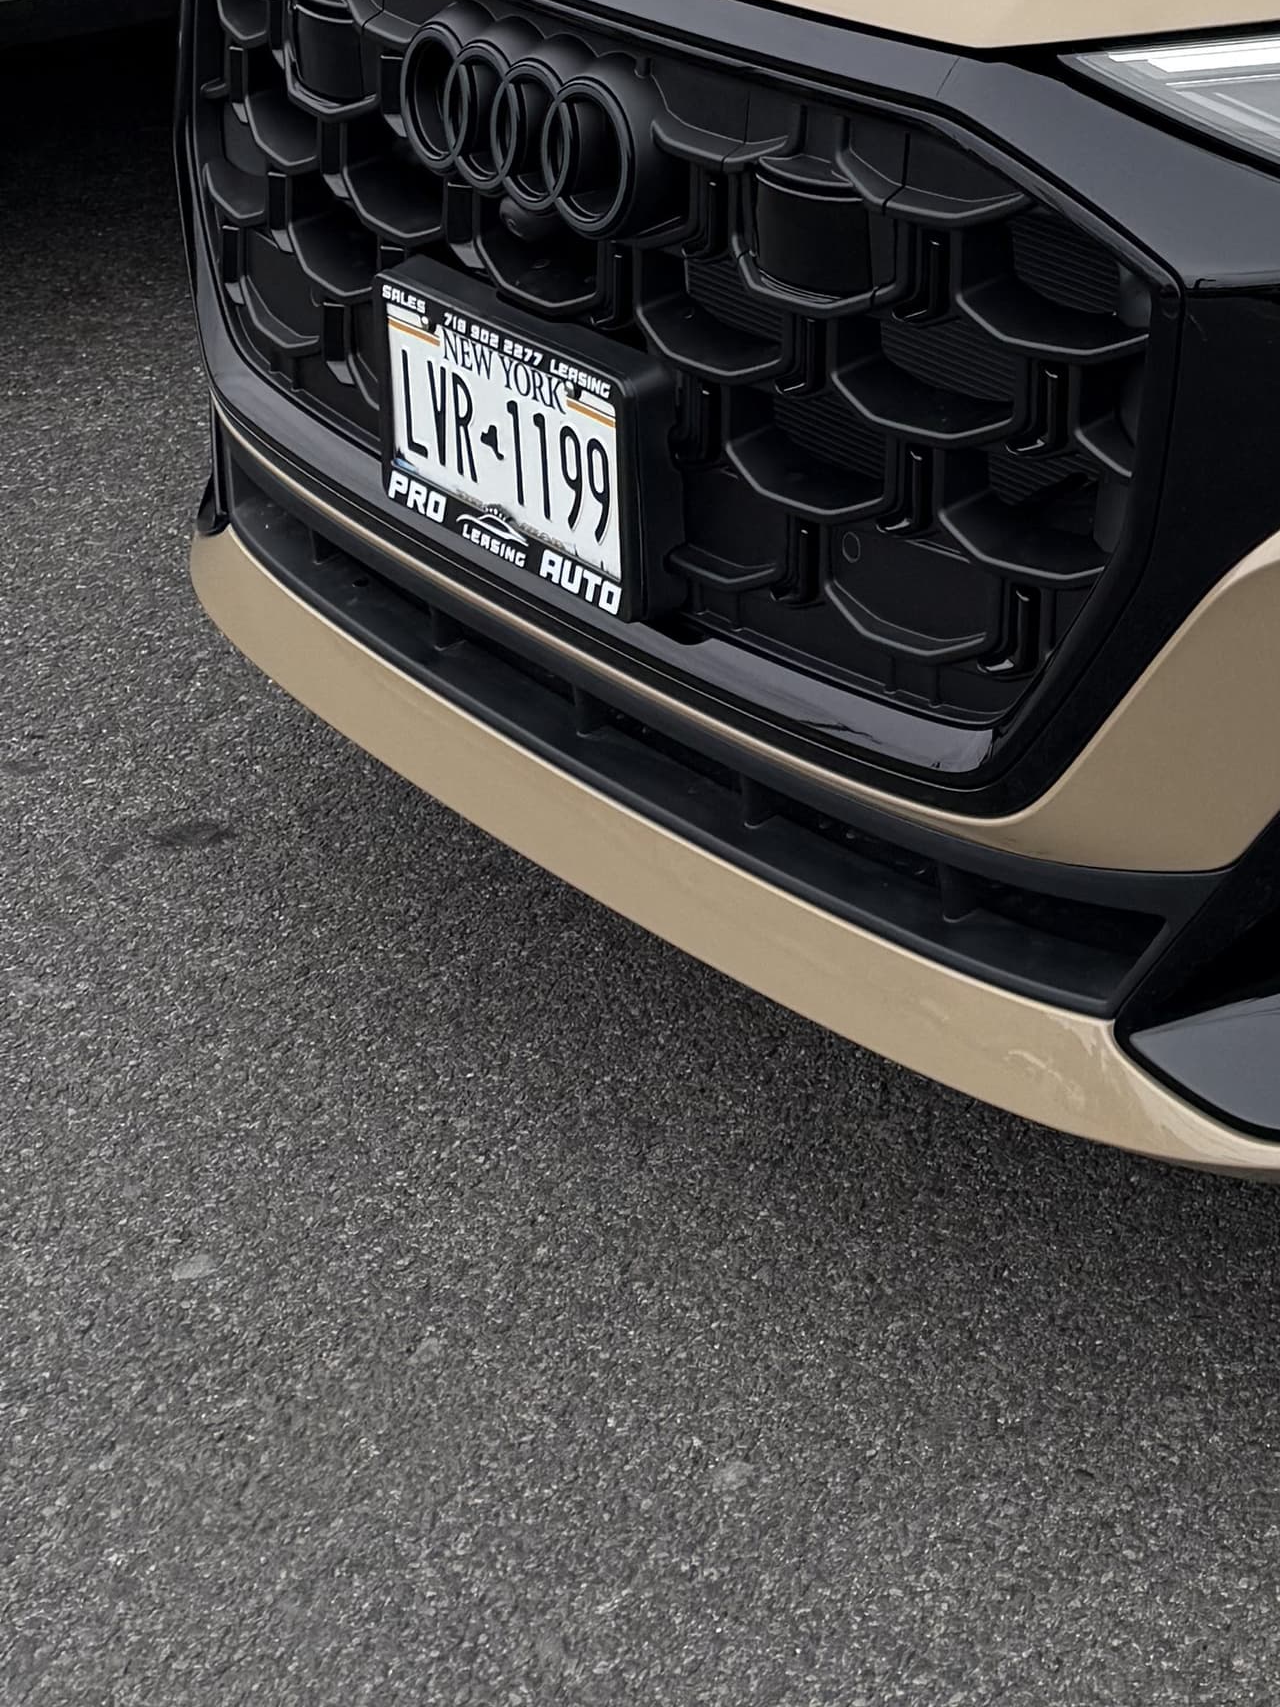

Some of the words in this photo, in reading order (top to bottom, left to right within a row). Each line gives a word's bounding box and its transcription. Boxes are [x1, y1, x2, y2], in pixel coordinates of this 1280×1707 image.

[382, 284, 426, 314] SALES
[444, 312, 466, 334] 718
[470, 323, 500, 348] 902
[503, 338, 543, 367] 2277
[549, 357, 611, 399] LEASING
[440, 325, 494, 380] NEW
[500, 355, 566, 415] YORK
[401, 345, 478, 484] LVR
[507, 399, 609, 546] 1199
[388, 471, 448, 523] PRO
[462, 522, 526, 568] LEASING
[539, 549, 622, 616] AUTO
